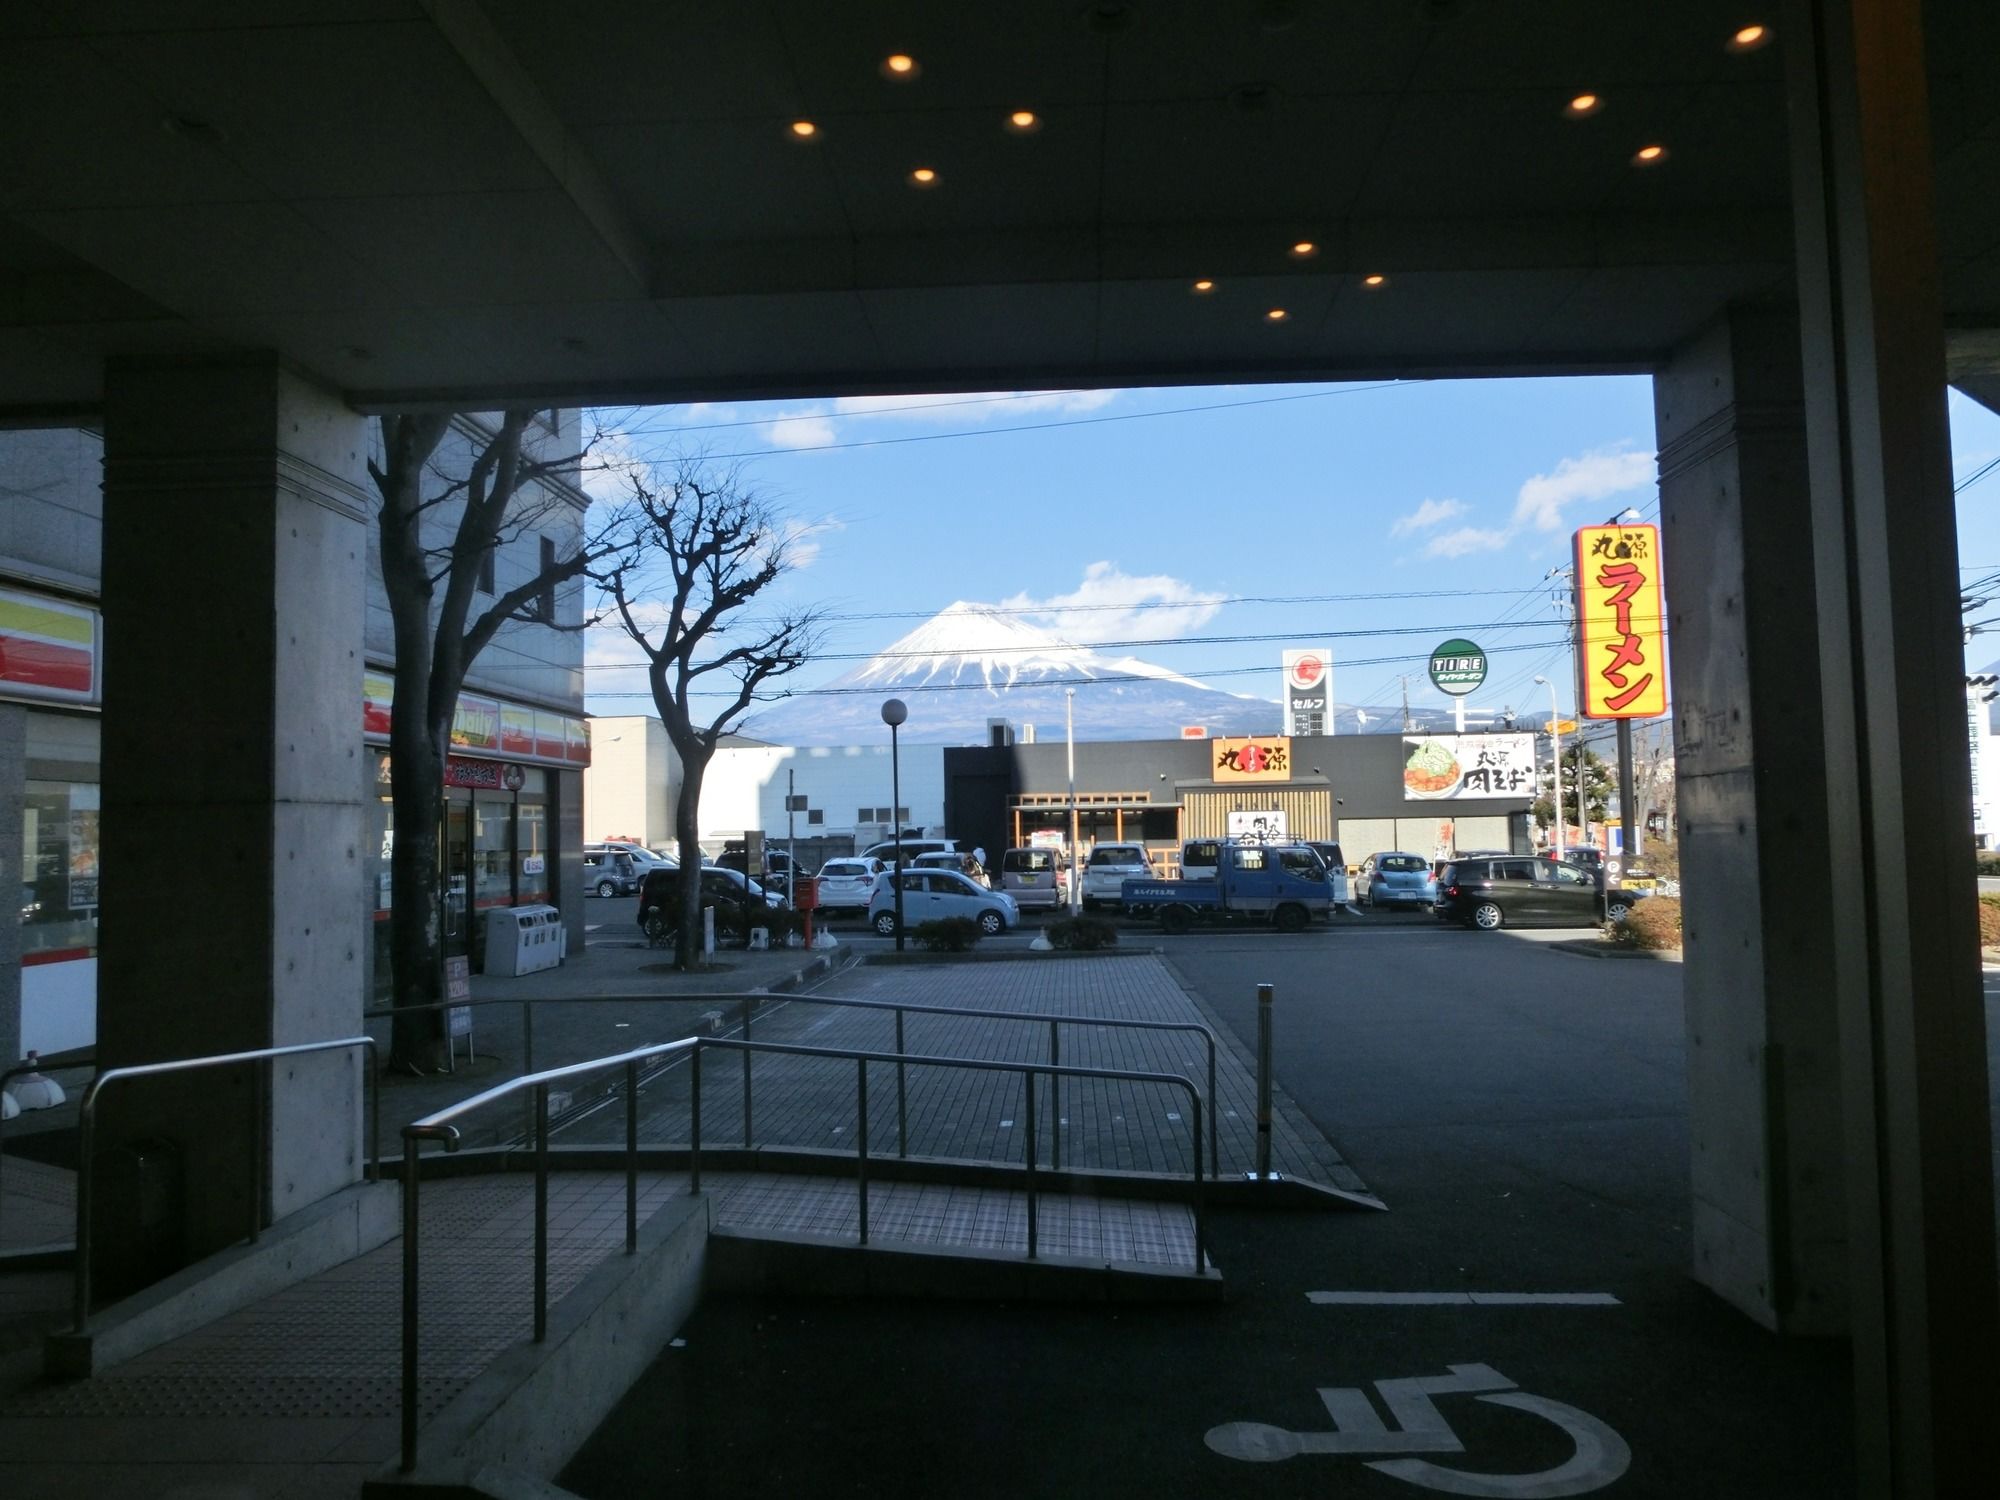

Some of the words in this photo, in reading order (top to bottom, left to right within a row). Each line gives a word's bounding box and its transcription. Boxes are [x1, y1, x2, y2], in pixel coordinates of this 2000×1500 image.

[1596, 562, 1652, 711] ラーメン
[1435, 659, 1481, 671] TIRE
[1292, 698, 1325, 710] セルフ
[1477, 751, 1510, 767] 丸源
[1463, 766, 1533, 793] 肉そば
